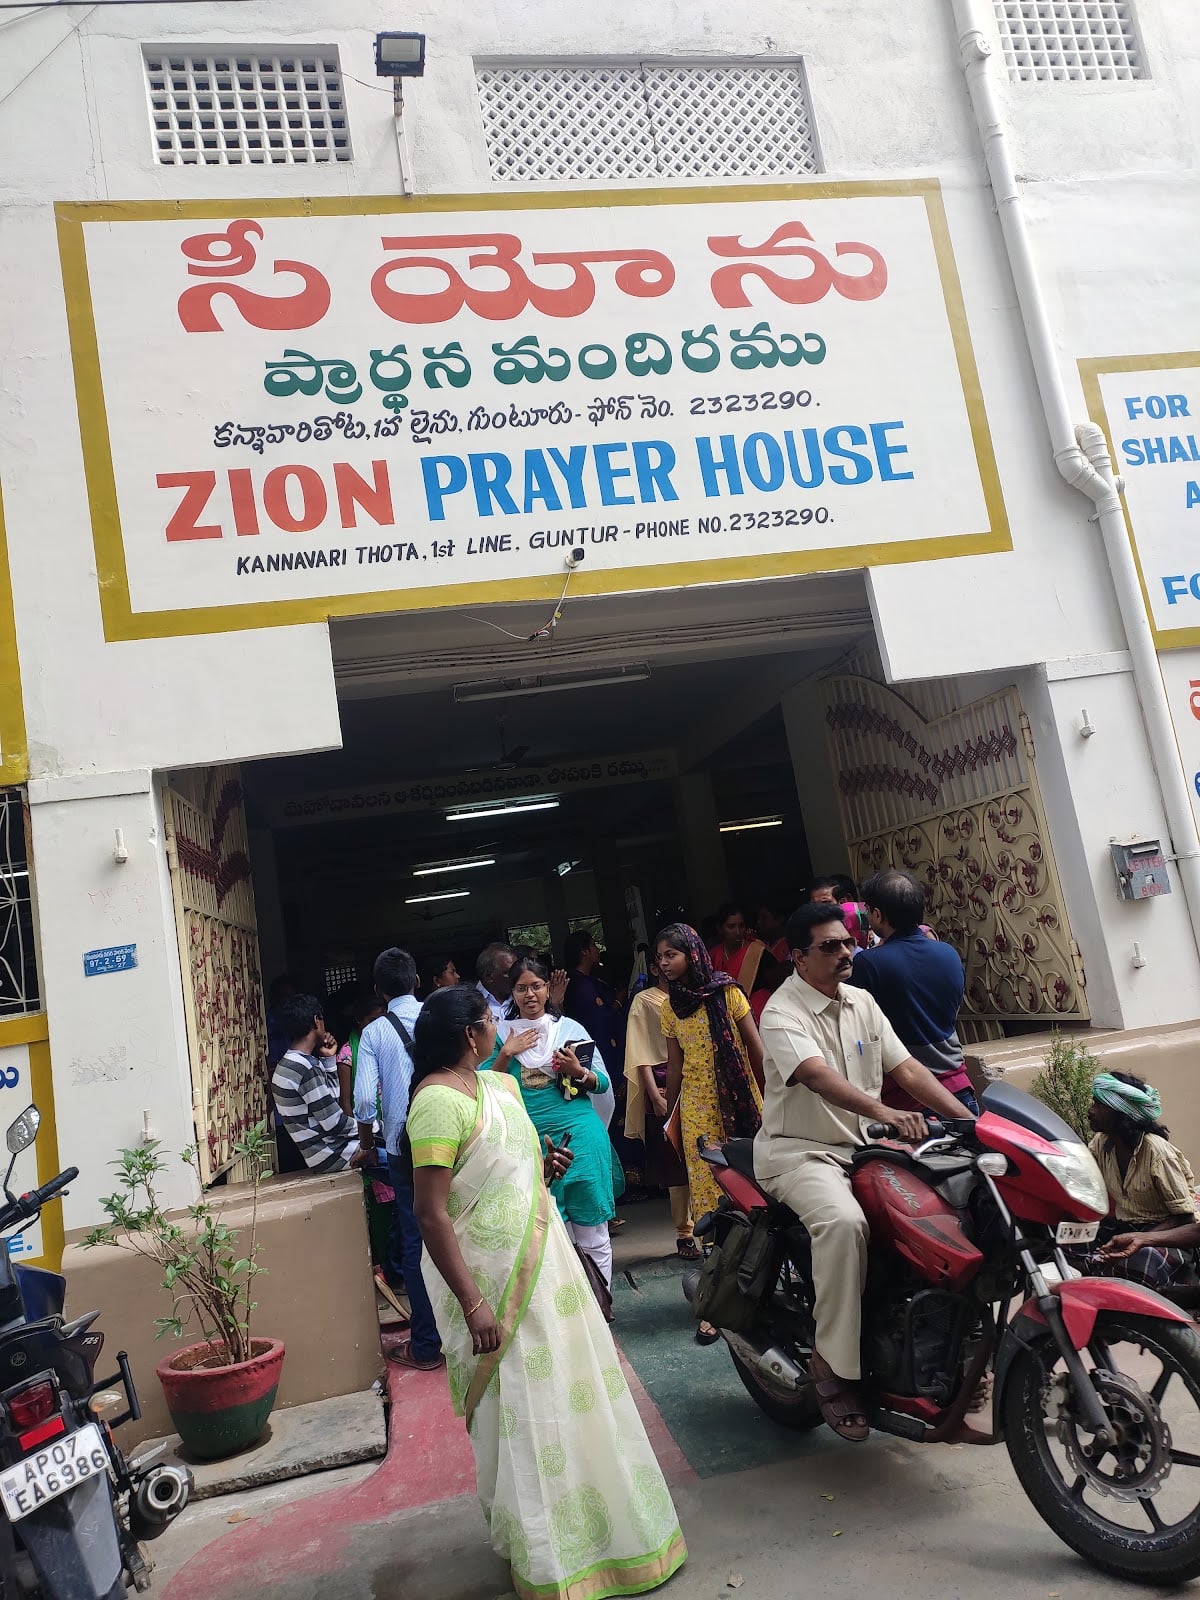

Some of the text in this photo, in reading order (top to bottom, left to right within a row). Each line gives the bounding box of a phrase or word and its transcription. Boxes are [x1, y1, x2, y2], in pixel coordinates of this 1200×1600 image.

[491, 321, 827, 386] మందిరము
[1124, 394, 1192, 420] FOR
[155, 420, 915, 543] ZION PRAYER HOUSE
[236, 548, 347, 575] KANNAVARI
[635, 518, 690, 539] PHONE
[1127, 857, 1163, 872] LETTER
[1141, 884, 1163, 896] BOX
[15, 1448, 106, 1513] EA6986
[24, 1435, 77, 1483] AP07
